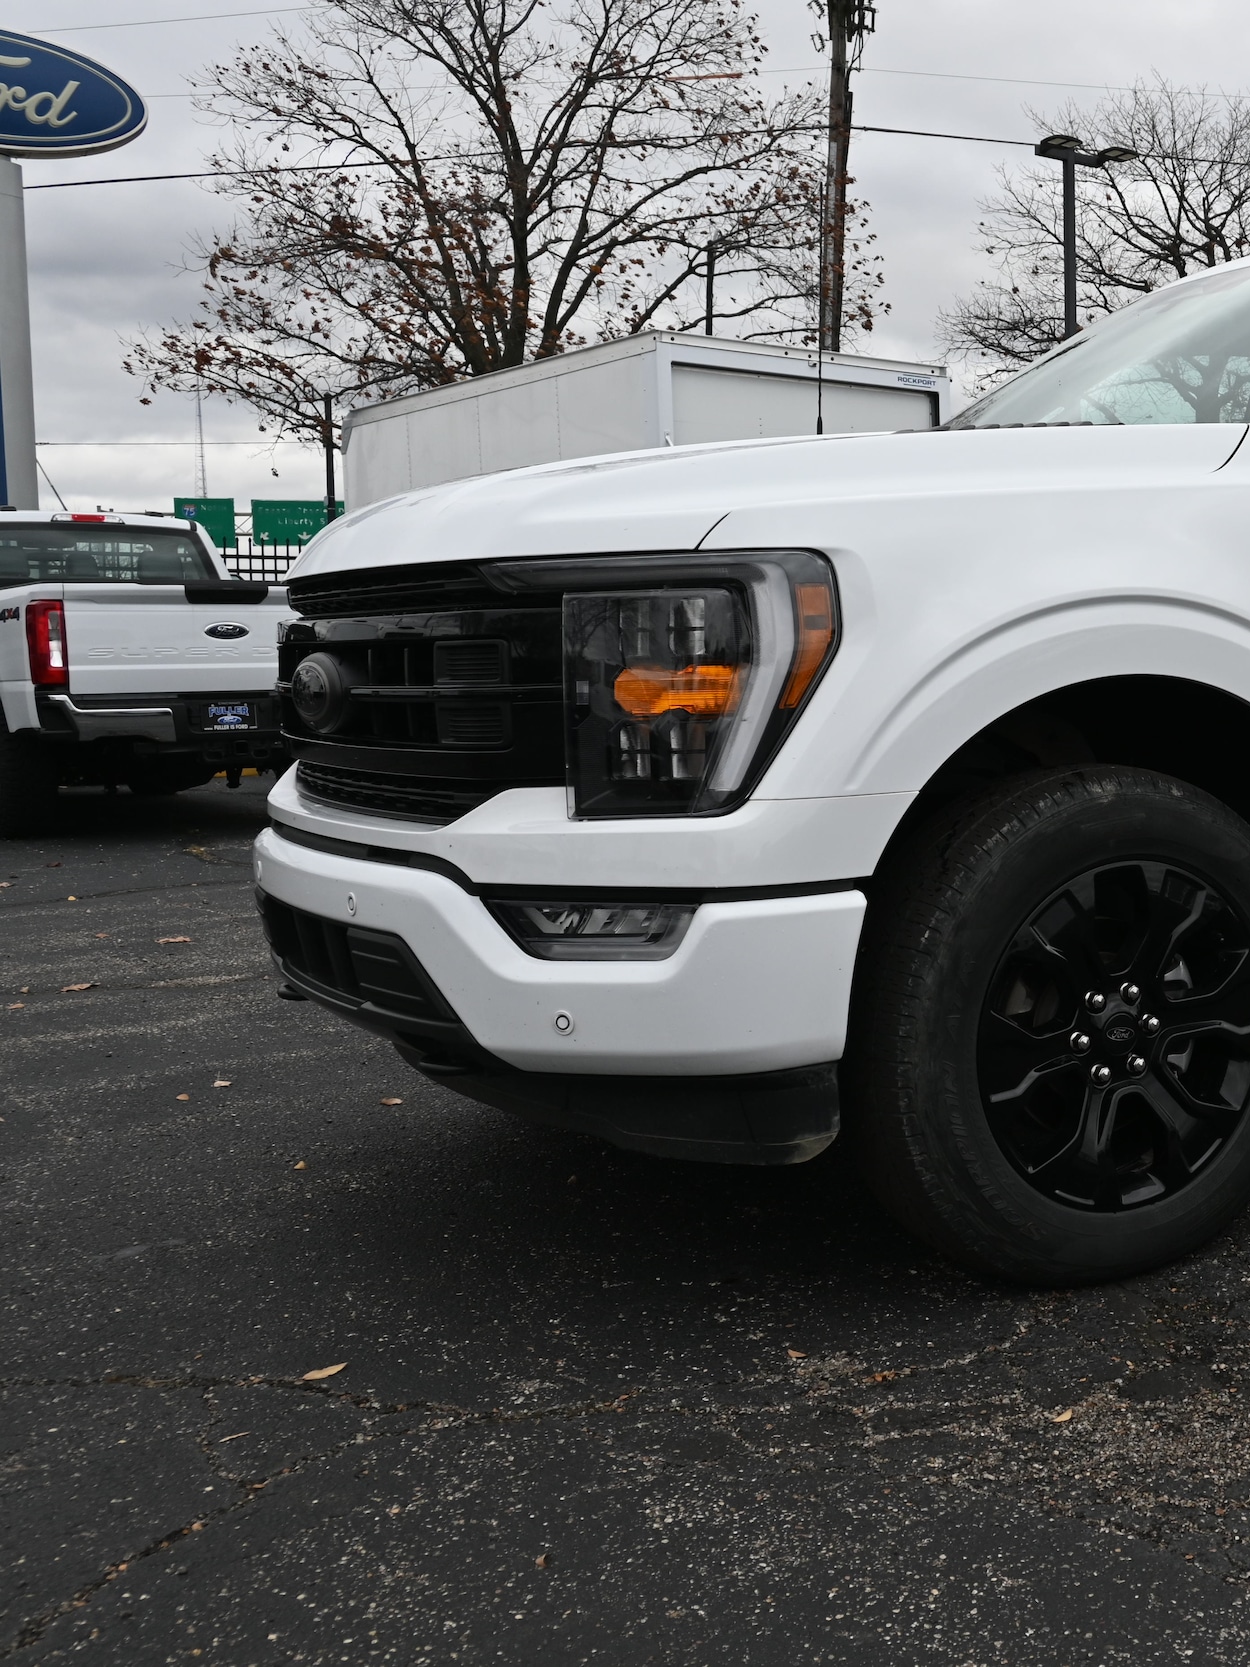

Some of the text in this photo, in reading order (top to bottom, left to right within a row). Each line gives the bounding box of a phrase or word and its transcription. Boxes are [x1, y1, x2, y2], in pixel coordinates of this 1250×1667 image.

[0, 54, 80, 128] rd
[897, 376, 937, 386] ROCKPORT
[183, 507, 196, 516] 75
[87, 647, 240, 658] SUPER
[208, 705, 250, 717] FULLER
